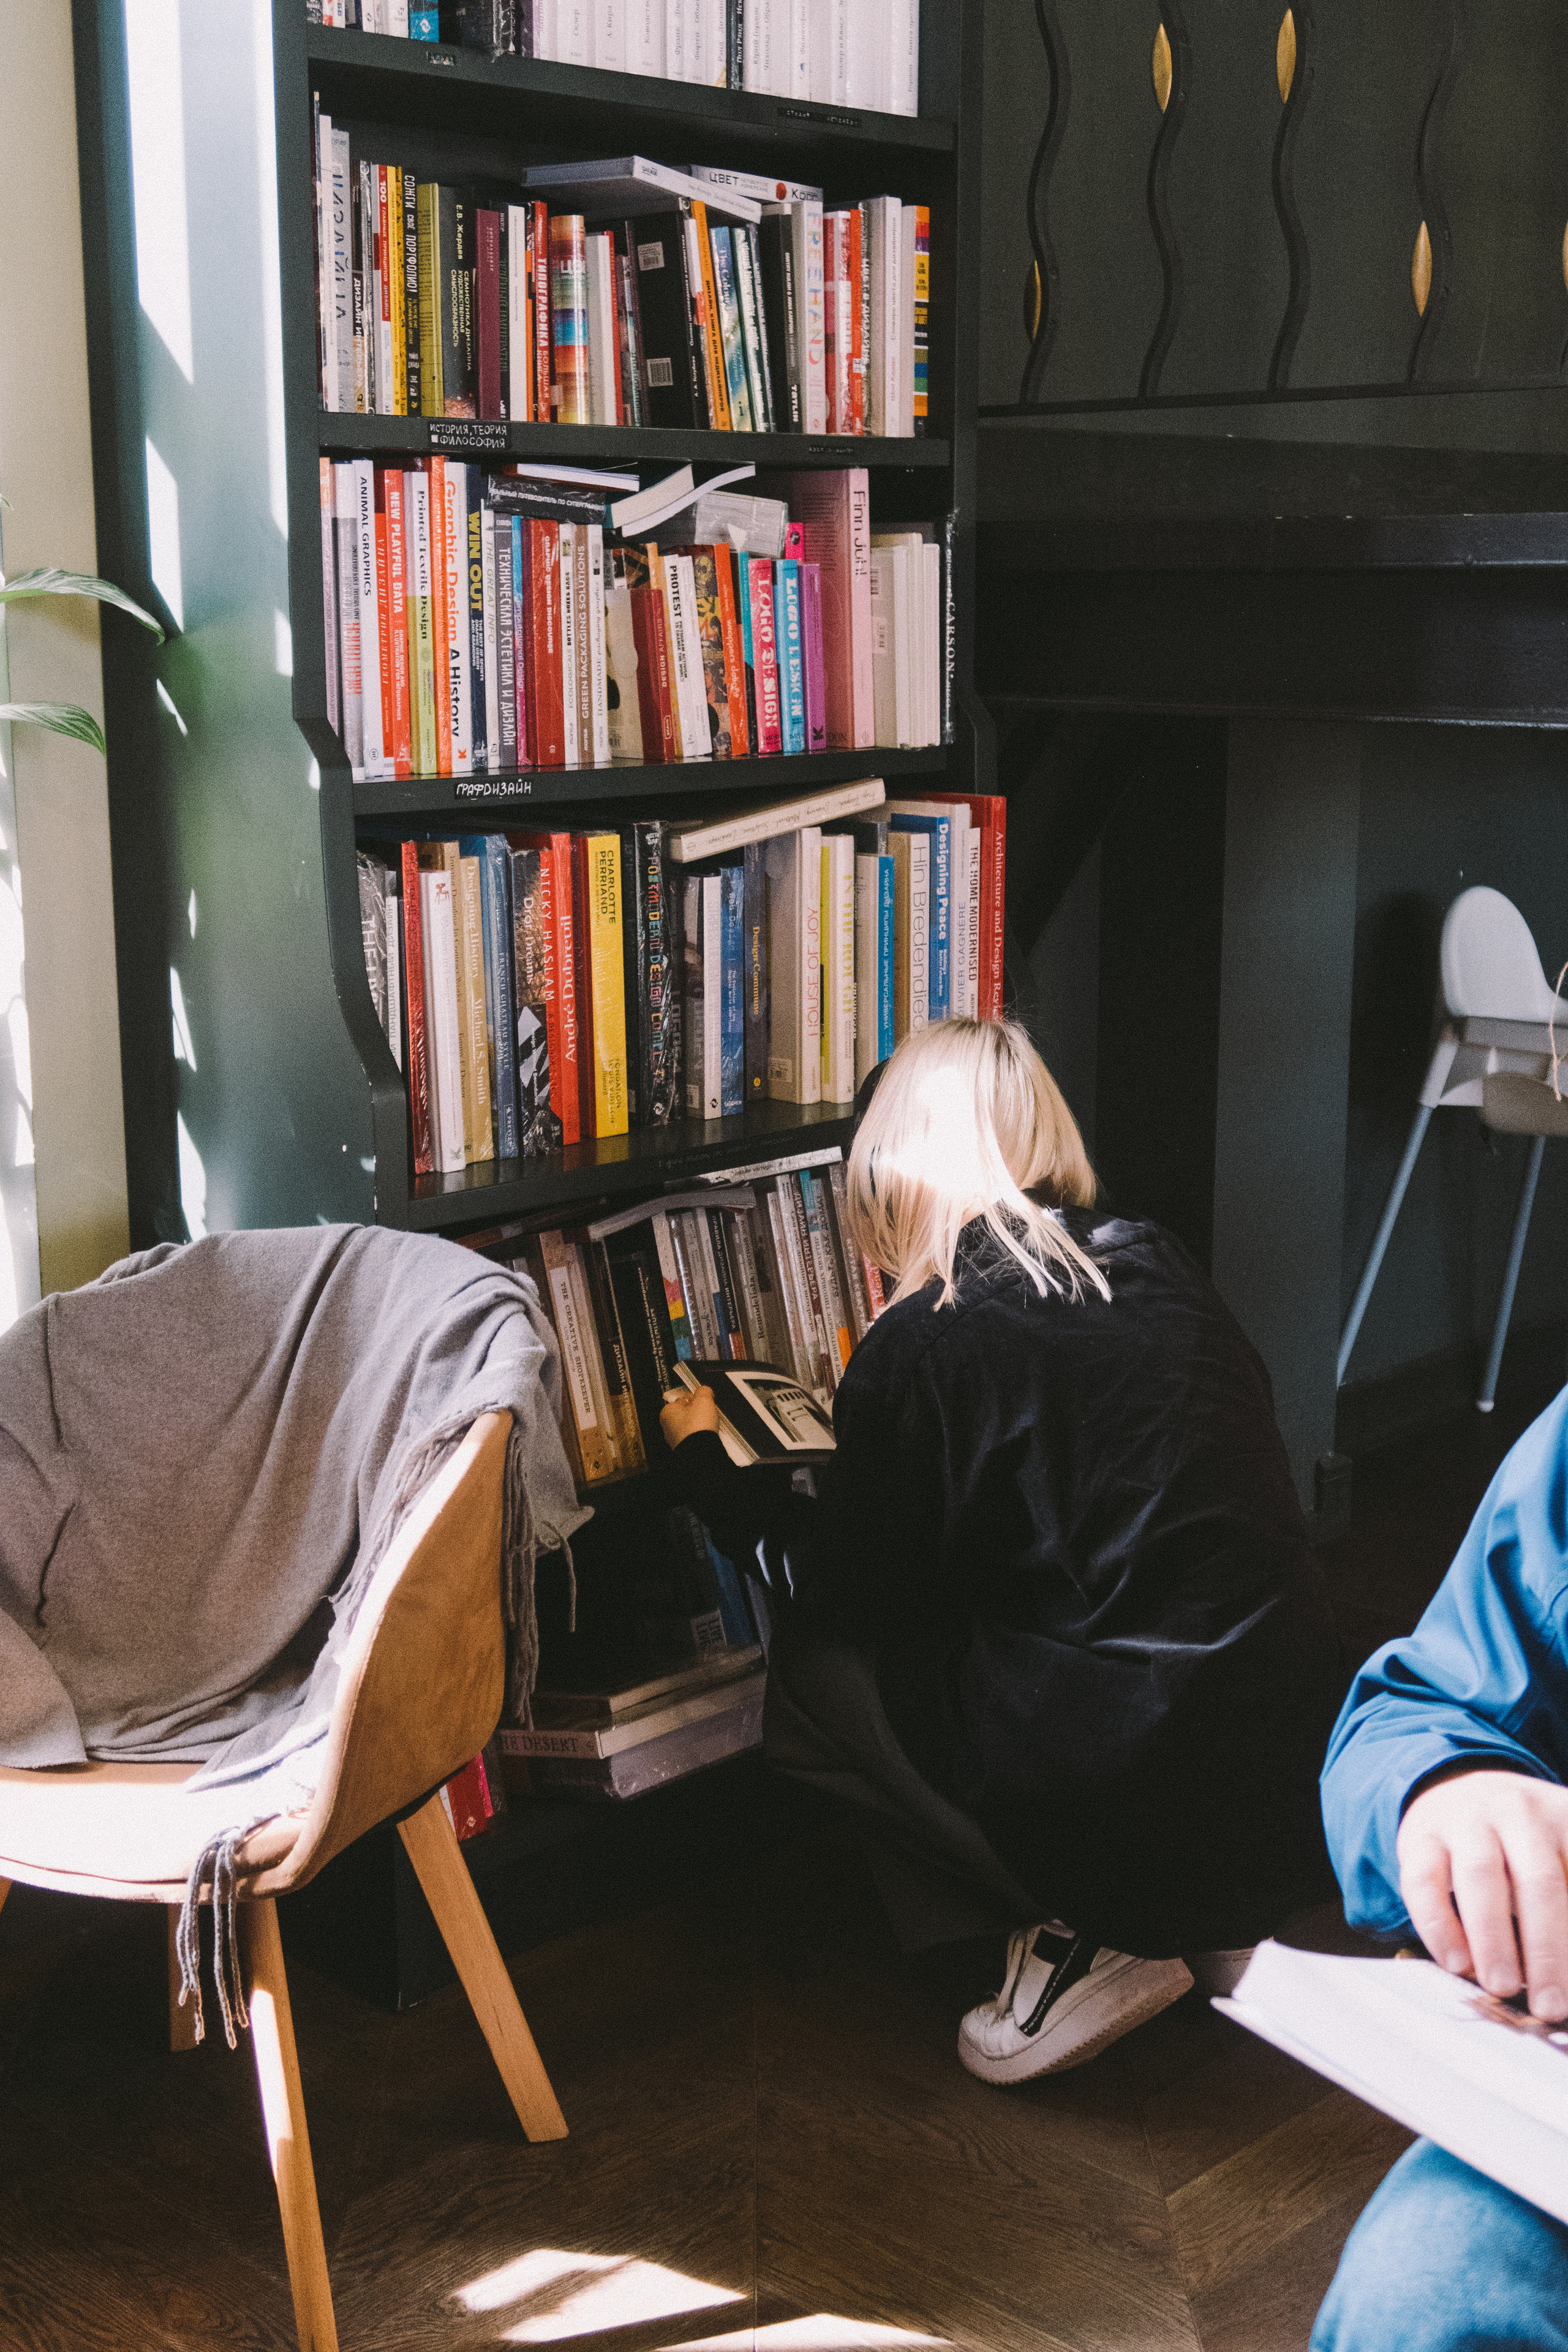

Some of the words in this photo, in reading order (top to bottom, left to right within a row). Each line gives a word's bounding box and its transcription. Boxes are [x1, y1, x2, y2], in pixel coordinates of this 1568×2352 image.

[404, 175, 417, 209] СОЖГИ
[709, 172, 739, 186] ЦВЕТ
[407, 214, 416, 230] СВОЕ
[455, 224, 464, 260] Жердев
[405, 235, 418, 293] ПОРТФОЛИО!
[353, 277, 364, 324] ДИЗАЙН
[450, 269, 459, 347] СМЫСЛООБРАЗНОСТЬ
[537, 258, 549, 347] ТИПОГРАФИКА
[429, 423, 473, 436] ИСТОРИЯ,
[473, 424, 508, 435] ТЕОРИЯ
[439, 435, 506, 448] ФИЛОСОФИЯ
[360, 476, 369, 529] ANIMAL
[390, 491, 401, 520] NEW
[417, 490, 427, 541] Printed
[445, 480, 458, 565] Graphic
[391, 524, 402, 578] PLAYFUL
[468, 511, 481, 559] WIN
[362, 532, 372, 597] GRAPHICS
[377, 538, 388, 608] ДИЗАЙНА
[419, 545, 428, 591] Textile
[469, 564, 483, 611] OUT
[486, 568, 495, 609] GREAT
[499, 547, 513, 625] ТЕХНИЧЕСКАЯ
[577, 545, 587, 609] SOLUTIONS
[393, 582, 403, 614] DATA
[447, 571, 459, 641] Design
[669, 565, 682, 617] PROTEST
[758, 578, 773, 643] LOGO
[786, 577, 799, 640] LOGO
[343, 622, 361, 661] TOUCH
[420, 595, 429, 640] Design
[657, 617, 666, 652] AFFAIRS
[726, 619, 736, 663] wrappers
[946, 601, 956, 673] CARSON
[450, 648, 460, 662] A
[479, 648, 484, 657] OF
[500, 630, 513, 685] ЭСТЕТИКА
[578, 611, 589, 678] PACKAGING
[660, 655, 668, 688] DESIGN
[761, 646, 778, 728] DESIGN
[450, 666, 461, 737] History
[500, 701, 516, 746] ДИЗАЙН
[581, 680, 589, 719] GREEN
[456, 778, 532, 796] ГРАФДИЗАЙН
[598, 850, 608, 915] PERRIAND
[913, 845, 927, 884] Hin
[936, 823, 949, 895] Designing
[466, 865, 476, 930] Designing
[540, 868, 552, 919] NICKY
[606, 850, 616, 924] CHARLOTTE
[523, 897, 535, 930] Dror
[807, 907, 820, 943] JOY
[938, 897, 949, 940] Peace
[469, 930, 479, 979] History
[524, 936, 535, 985] Dreams
[542, 930, 555, 1001] HASLAM
[560, 914, 574, 1000] Dubreuil
[751, 925, 761, 962] Design
[807, 945, 820, 970] OF
[752, 963, 761, 1016] Commune
[807, 974, 820, 1036] HOUSE
[473, 998, 484, 1047] Michael
[500, 993, 508, 1038] CHATEAU
[563, 1003, 576, 1063] André
[476, 1050, 486, 1063] S.
[477, 1066, 487, 1105] Smith
[793, 1192, 809, 1237] ДИЗАЙН
[801, 1239, 820, 1301] ИНТЕРЬЕРА
[560, 1281, 569, 1301] THE
[637, 1267, 651, 1317] моделирования
[711, 1215, 722, 1250] ПРАВИЛА
[717, 1251, 728, 1286] ДИЗАЙНА
[724, 1287, 737, 1330] ИНТЕРЬЕРА
[564, 1304, 579, 1352] CREATIVE
[575, 1356, 592, 1414] SHOPKEEPER
[612, 1343, 626, 1383] ДИЗАЙН
[654, 1355, 663, 1382] Техника
